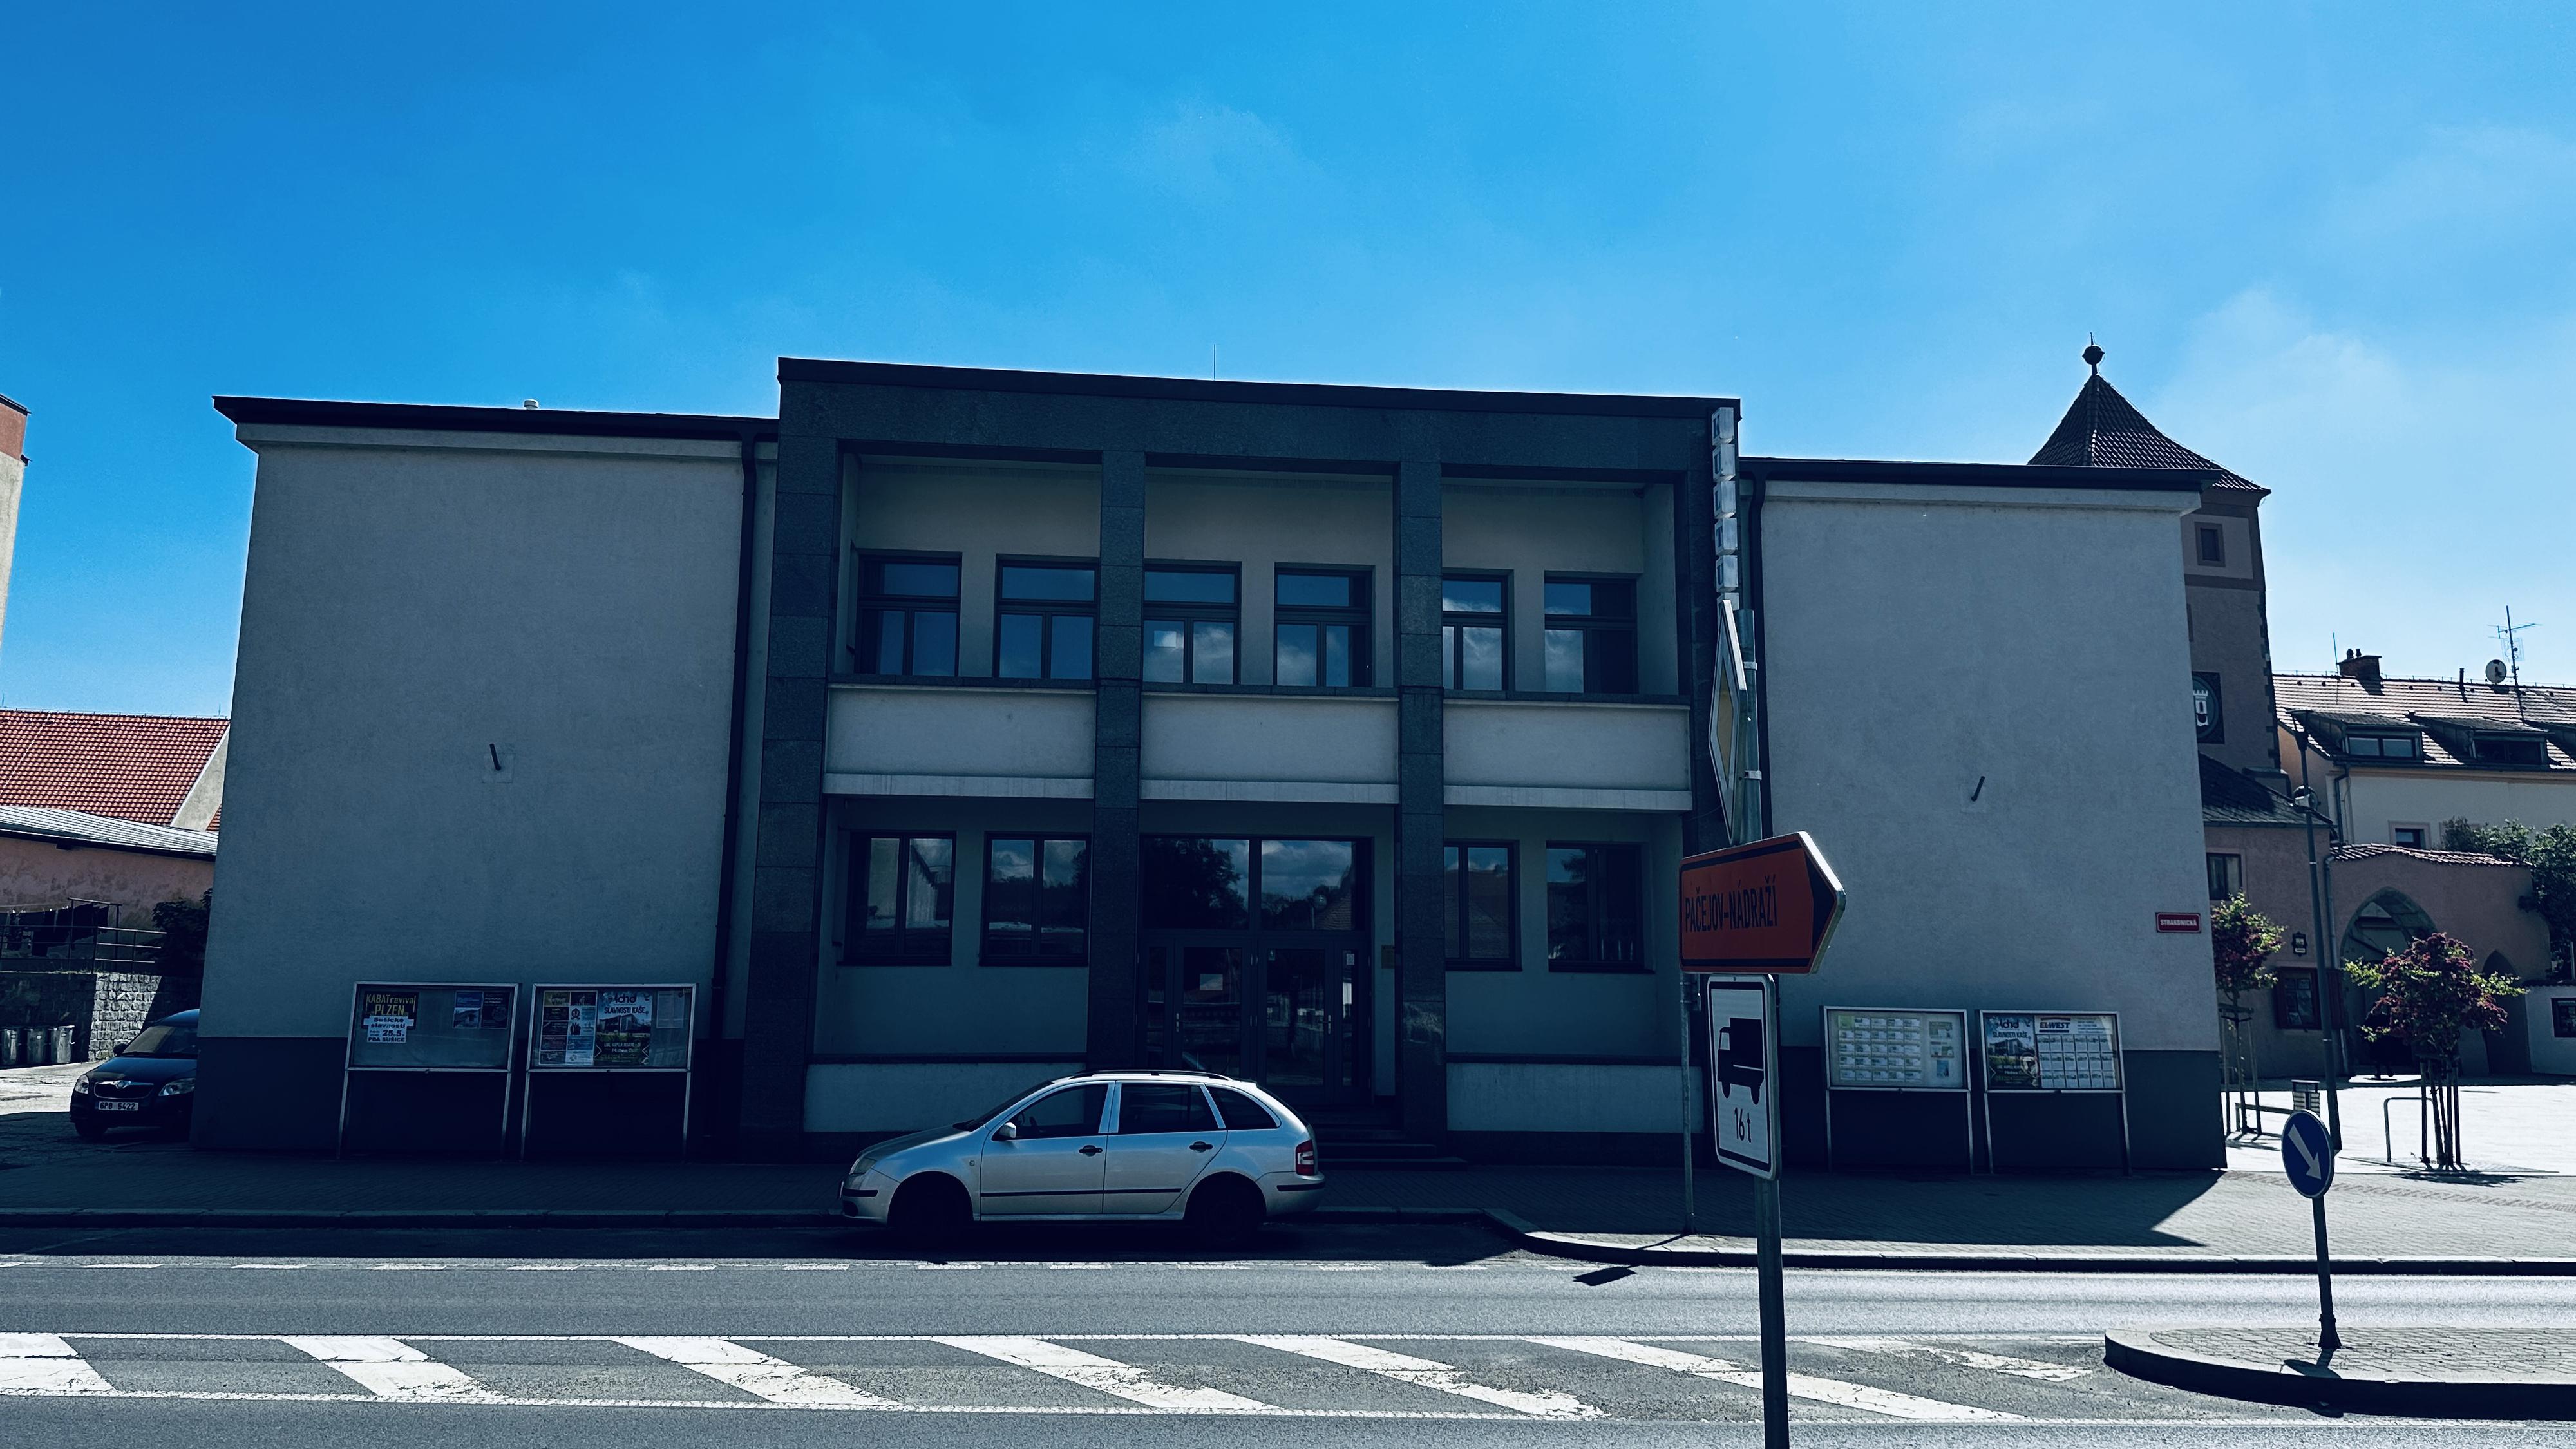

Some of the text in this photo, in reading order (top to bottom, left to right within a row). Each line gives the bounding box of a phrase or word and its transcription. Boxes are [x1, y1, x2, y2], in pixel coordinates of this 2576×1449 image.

[1685, 875, 1777, 933] PAČEJOV-NÁDRAŽÍ
[1734, 1107, 1752, 1143] 16 t
